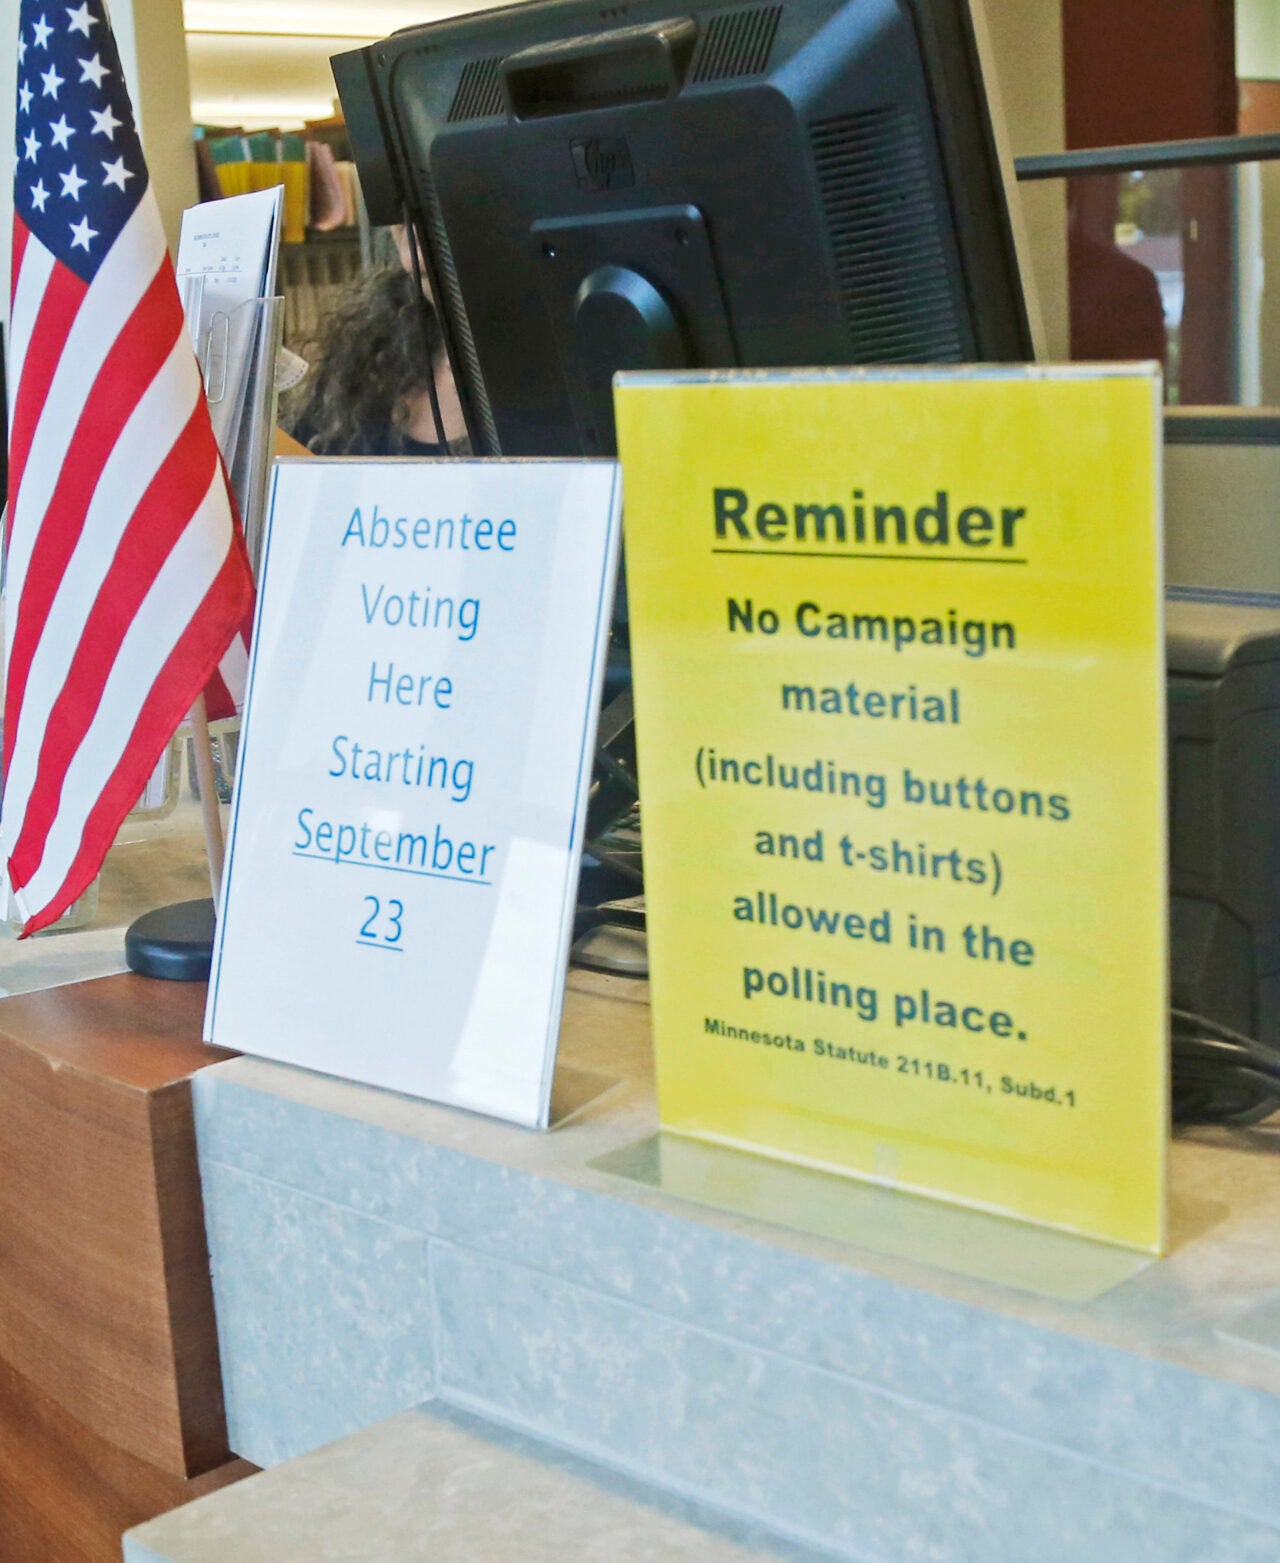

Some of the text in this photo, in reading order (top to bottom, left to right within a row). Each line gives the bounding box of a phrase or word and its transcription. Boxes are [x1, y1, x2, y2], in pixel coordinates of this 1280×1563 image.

[341, 504, 518, 553] Absentee
[711, 486, 1028, 550] Reminder
[360, 583, 481, 643] Voting
[726, 596, 1017, 659] No Campaign
[367, 661, 454, 710] Here
[781, 682, 961, 725] material
[328, 734, 476, 804] Starting
[694, 746, 1072, 822] (including buttons
[292, 807, 496, 877] September
[754, 829, 1003, 897] and t-shirts)
[358, 894, 405, 945] 23
[732, 890, 1036, 968] allowed in the
[742, 965, 1028, 1042] polling place.
[704, 1016, 1076, 1108] Minnesota Statute 211B.11, Subd.1
